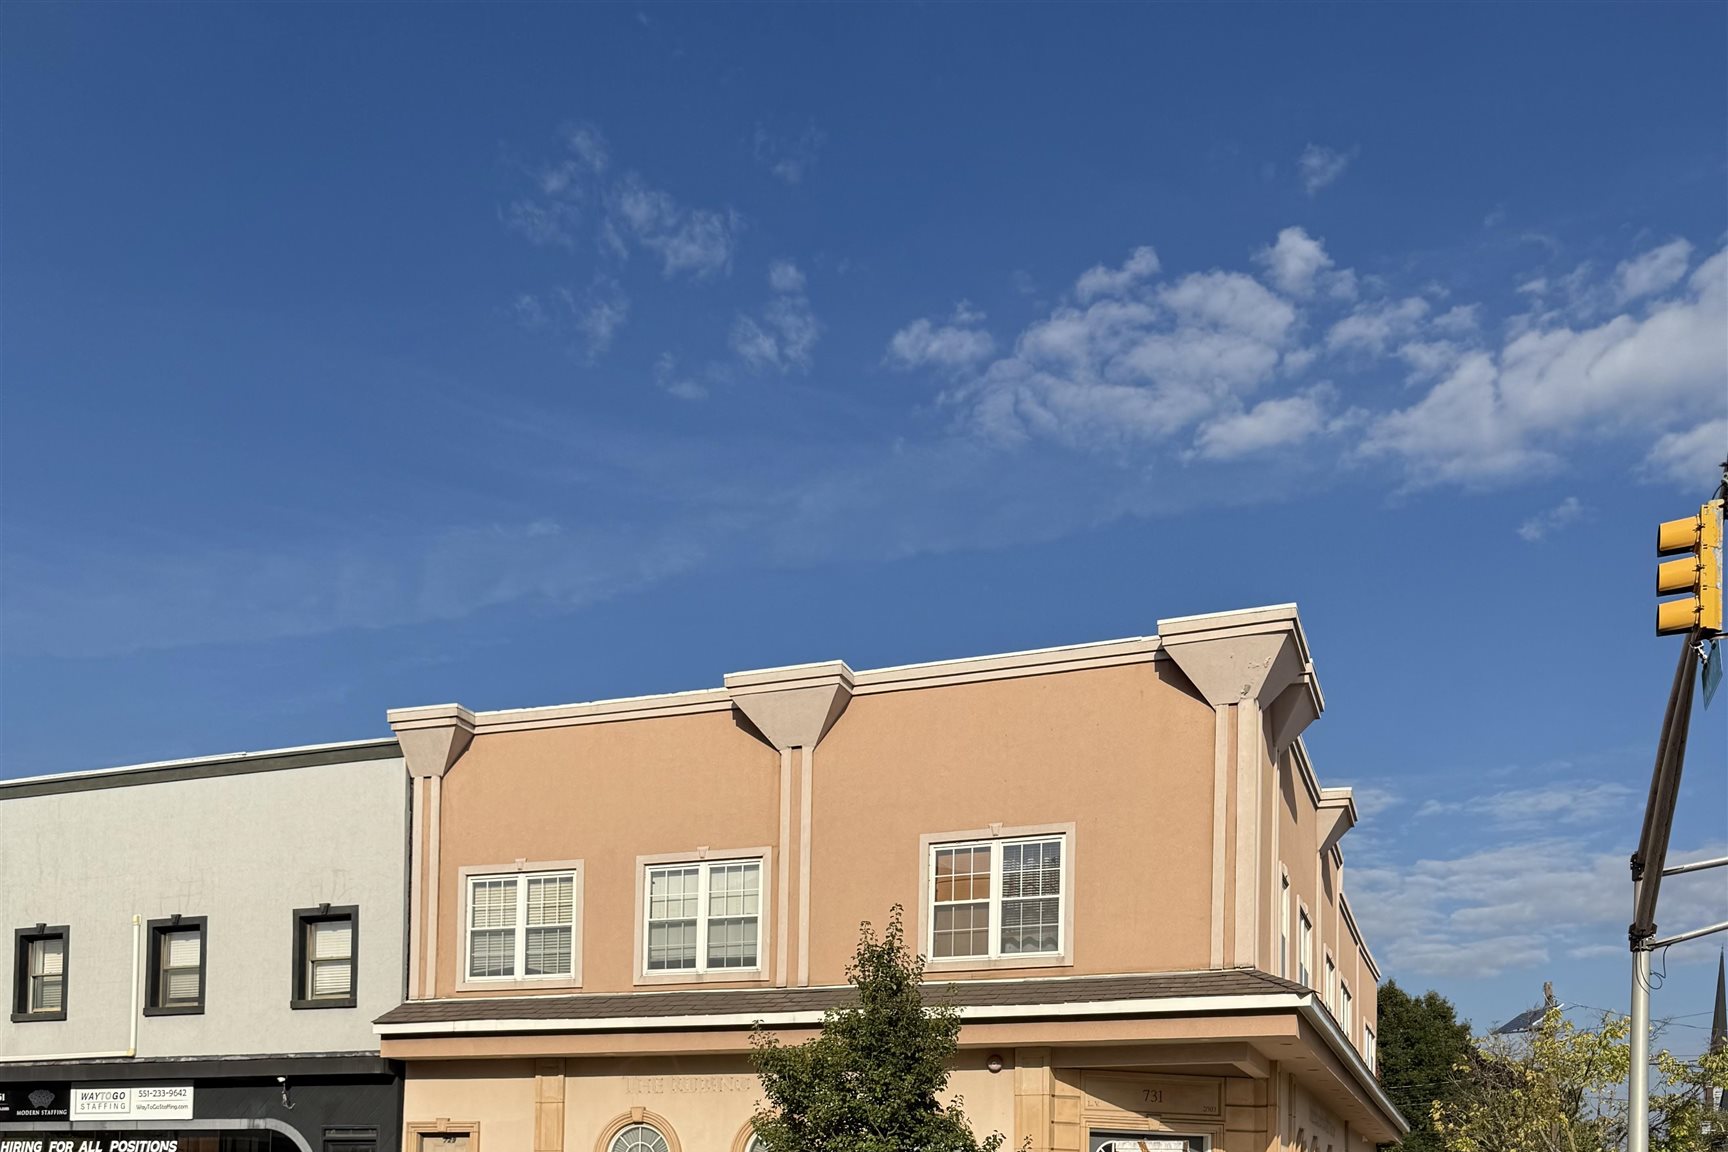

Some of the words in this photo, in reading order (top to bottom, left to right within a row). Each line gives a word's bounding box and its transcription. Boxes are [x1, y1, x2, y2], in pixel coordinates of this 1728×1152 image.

[623, 1076, 664, 1094] THE
[138, 1089, 188, 1098] 551-233-9642
[1142, 1089, 1164, 1104] 731
[41, 1108, 68, 1116] STAFFING
[80, 1103, 126, 1111] STAFFING
[78, 1140, 103, 1152] ALL
[109, 1140, 178, 1152] POSITIONS
